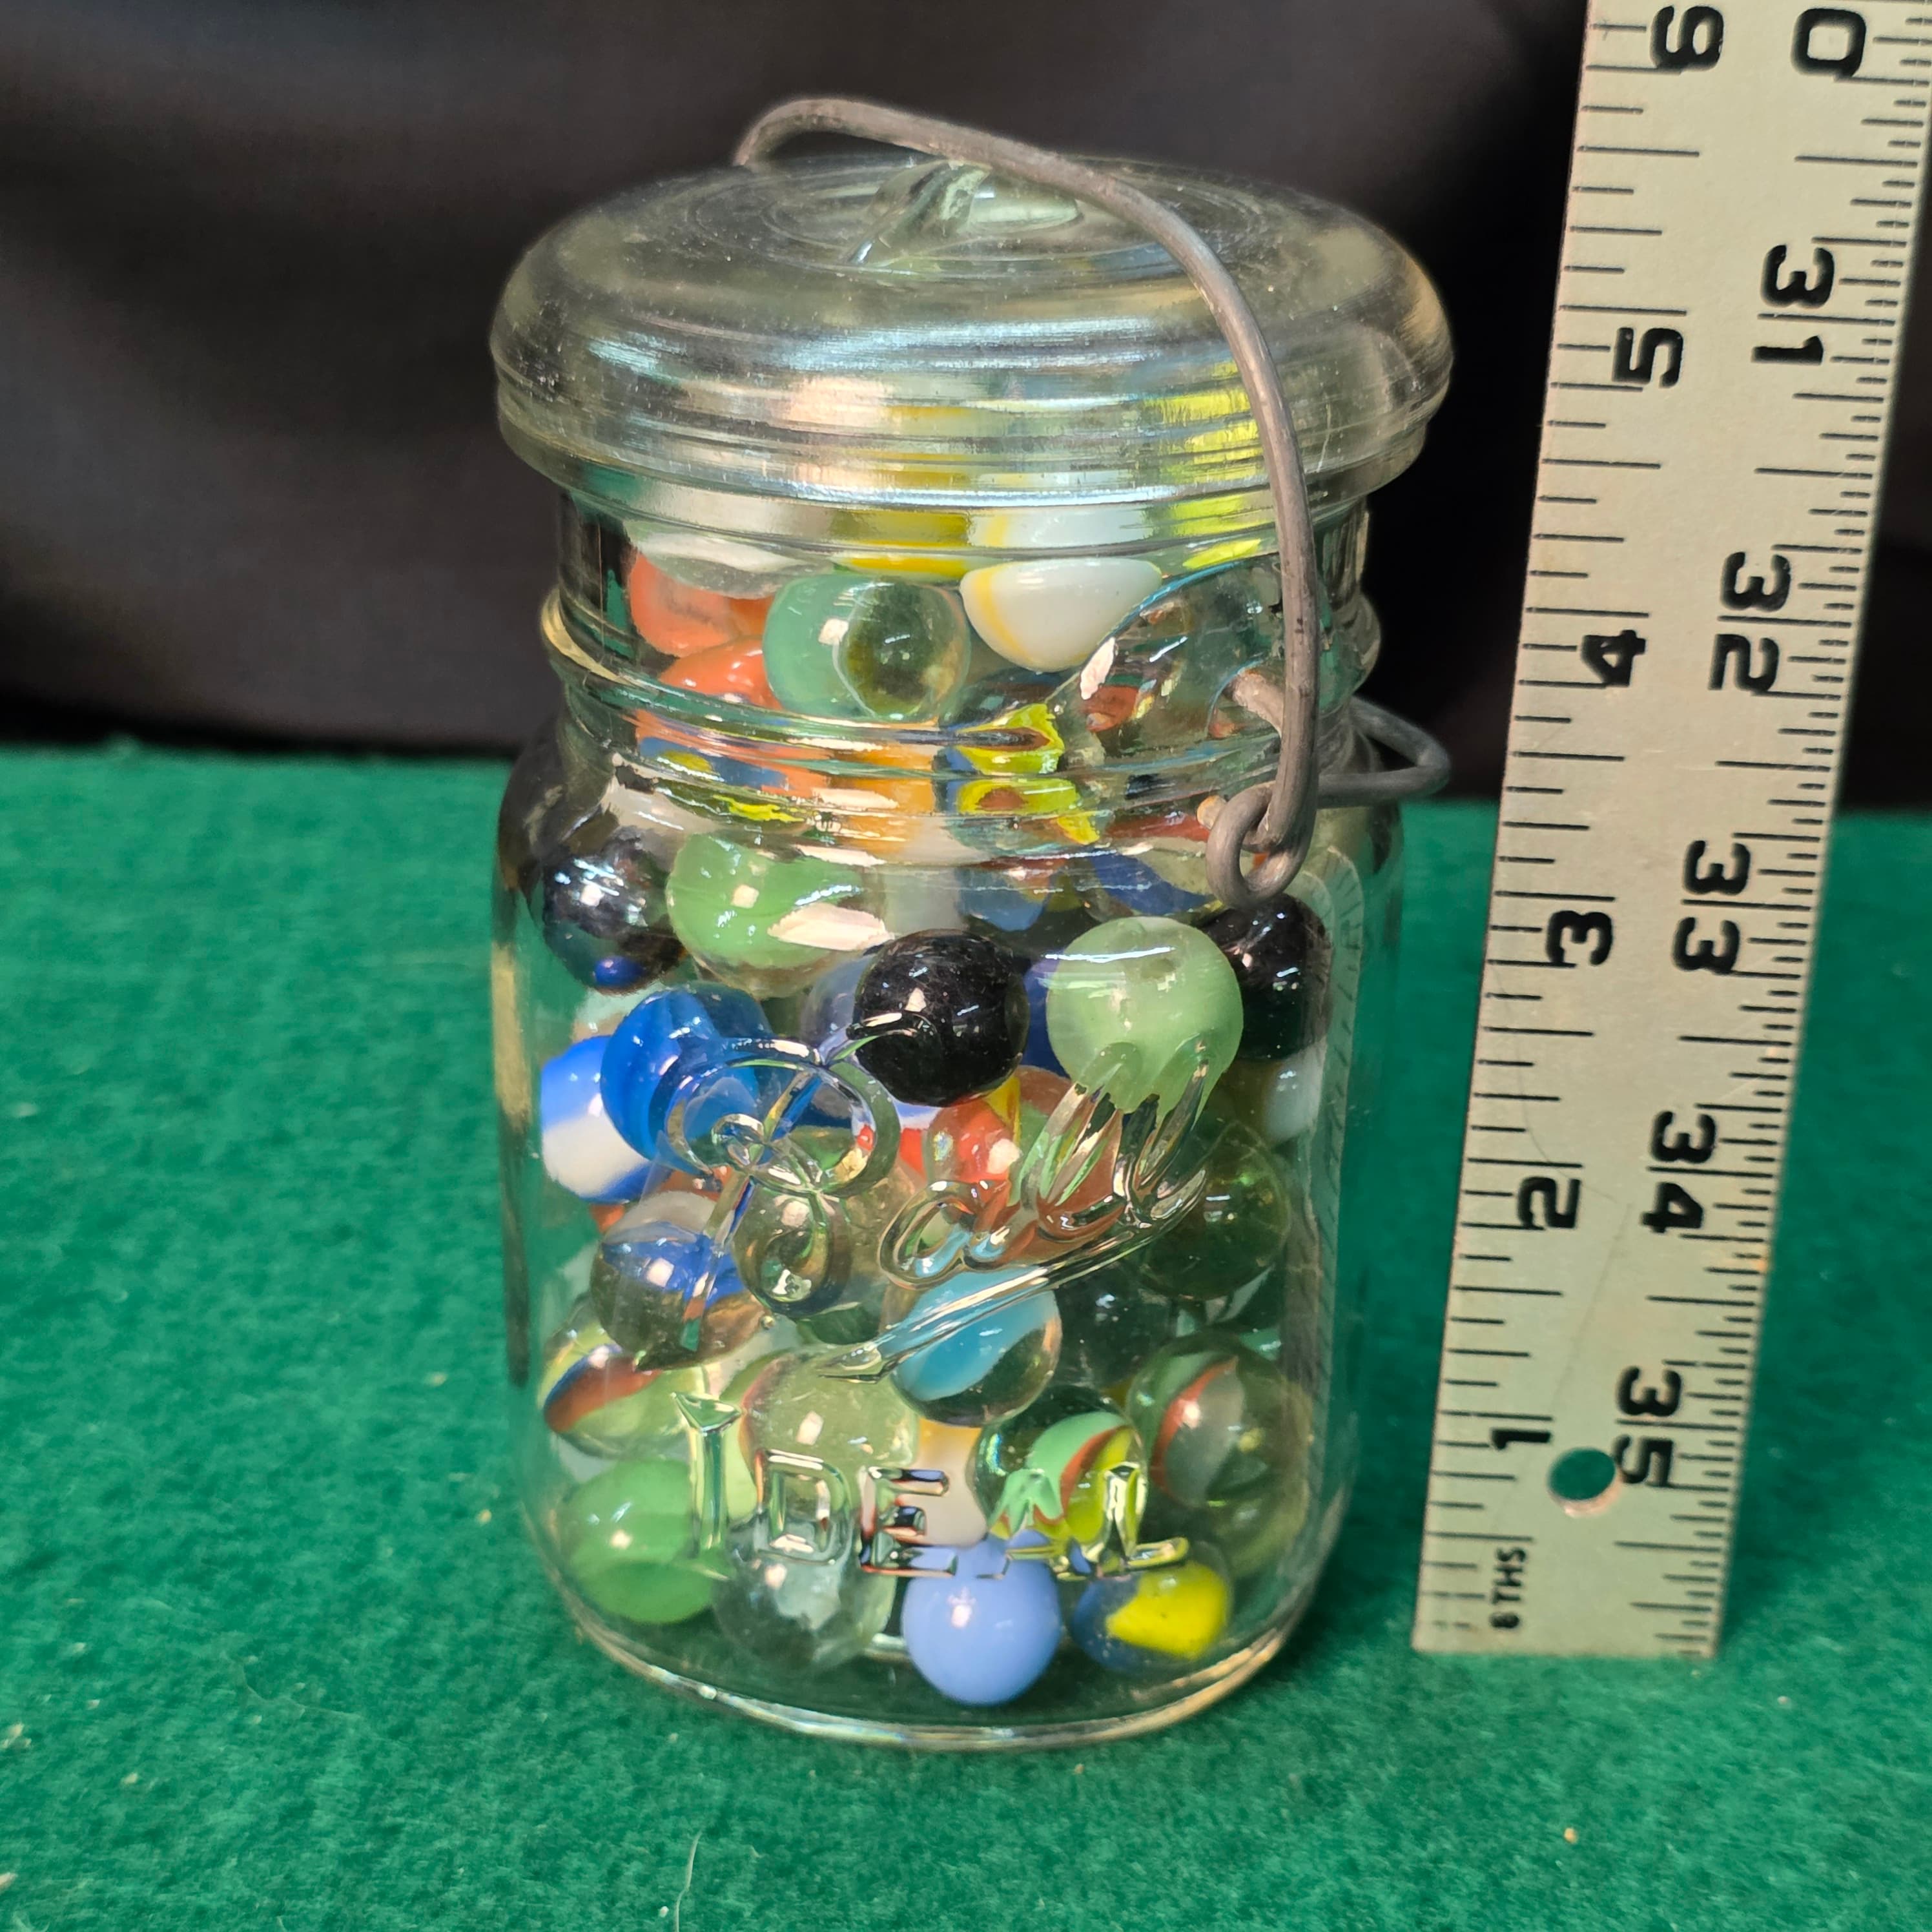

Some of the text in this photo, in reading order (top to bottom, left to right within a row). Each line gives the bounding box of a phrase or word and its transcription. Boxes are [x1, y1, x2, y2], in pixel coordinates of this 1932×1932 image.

[1650, 5, 1725, 71] 6
[1751, 245, 1836, 363] 31
[1612, 327, 1685, 387] 5
[1580, 630, 1647, 687] 4
[1707, 552, 1792, 692] 32
[1545, 909, 1613, 966] 3
[1673, 839, 1751, 974] 33
[650, 1012, 1211, 1353] Ball
[1517, 1176, 1583, 1229] 2
[1641, 1111, 1717, 1235] 34
[1490, 1426, 1554, 1451] 1
[1614, 1366, 1683, 1488] 35
[670, 1393, 1190, 1581] IDEAL
[1489, 1547, 1528, 1630] 8THS
